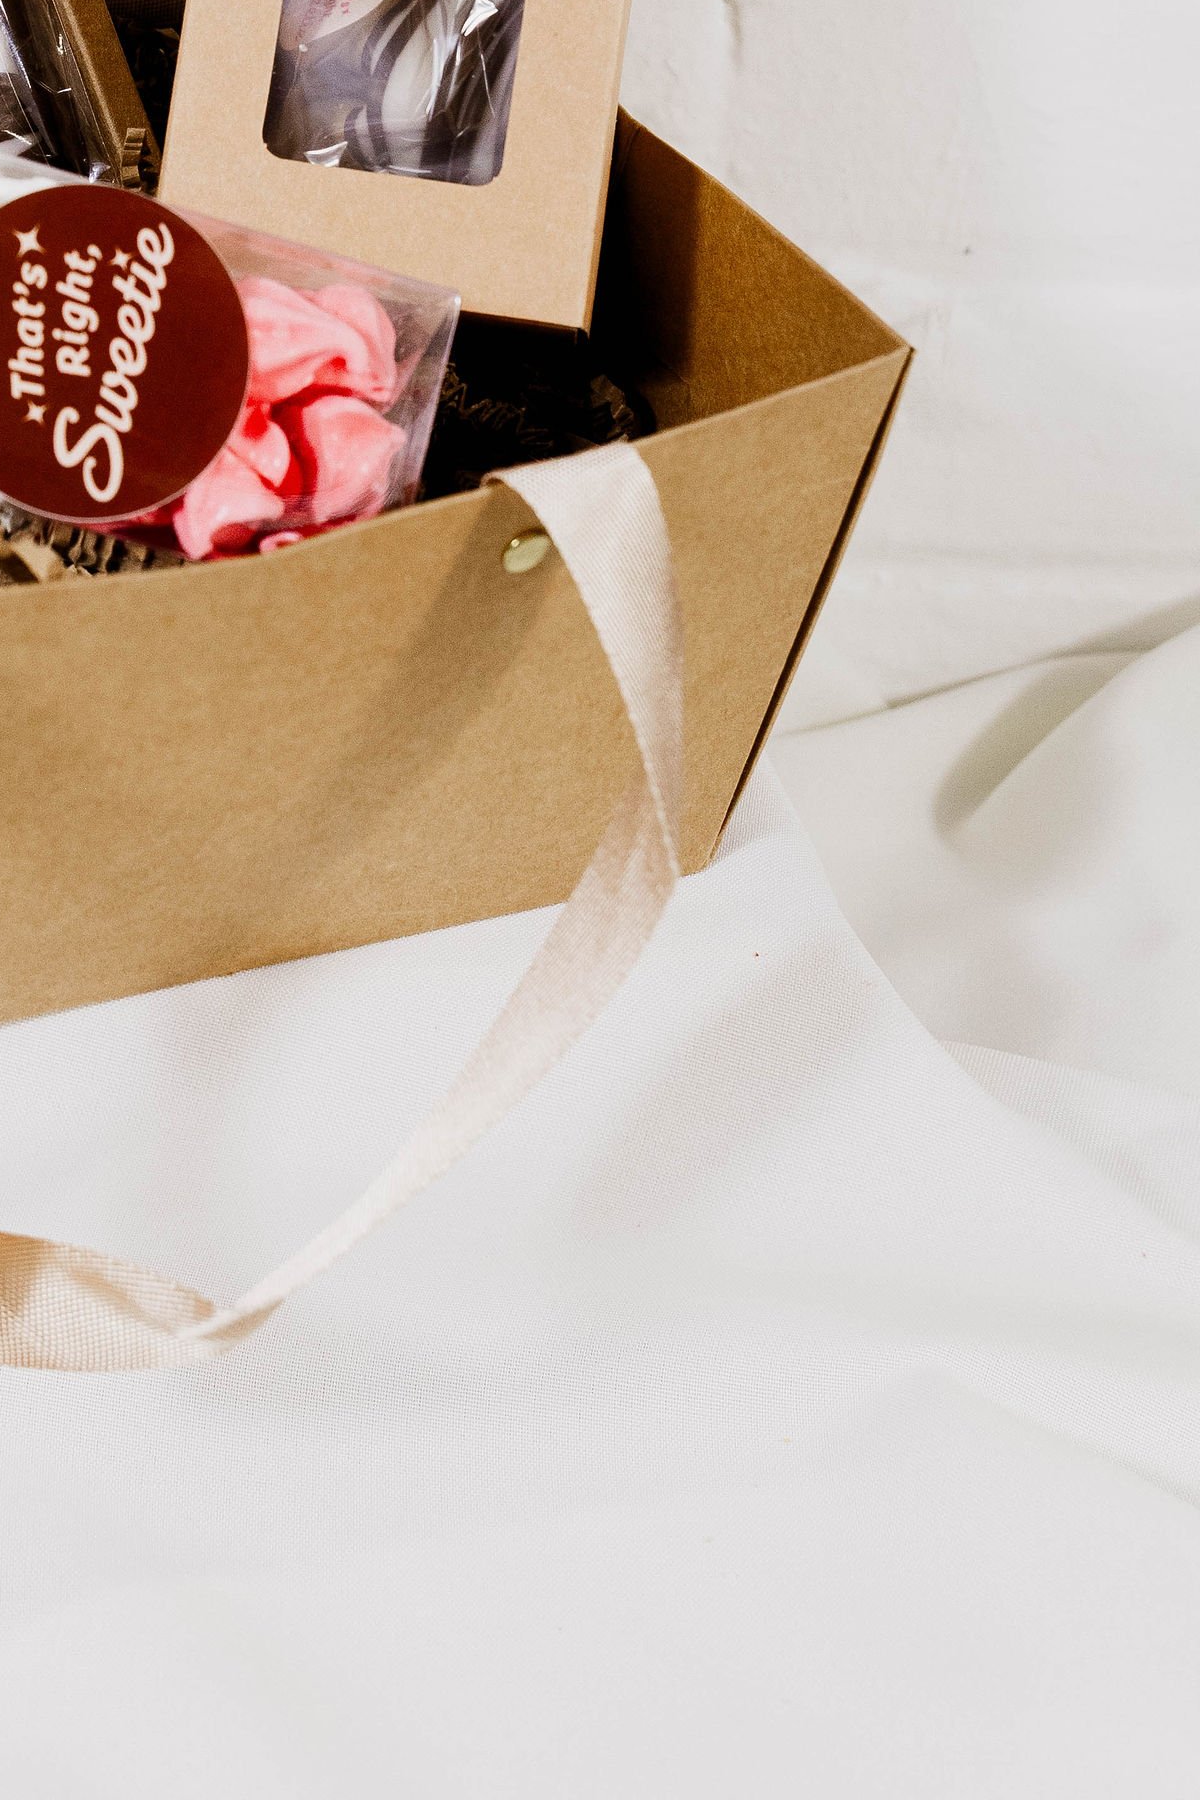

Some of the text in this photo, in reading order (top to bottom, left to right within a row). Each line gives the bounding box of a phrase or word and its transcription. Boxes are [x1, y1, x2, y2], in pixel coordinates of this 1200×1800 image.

[8, 261, 48, 400] That's
[51, 243, 102, 378] Right,
[53, 222, 175, 503] Sweetie
